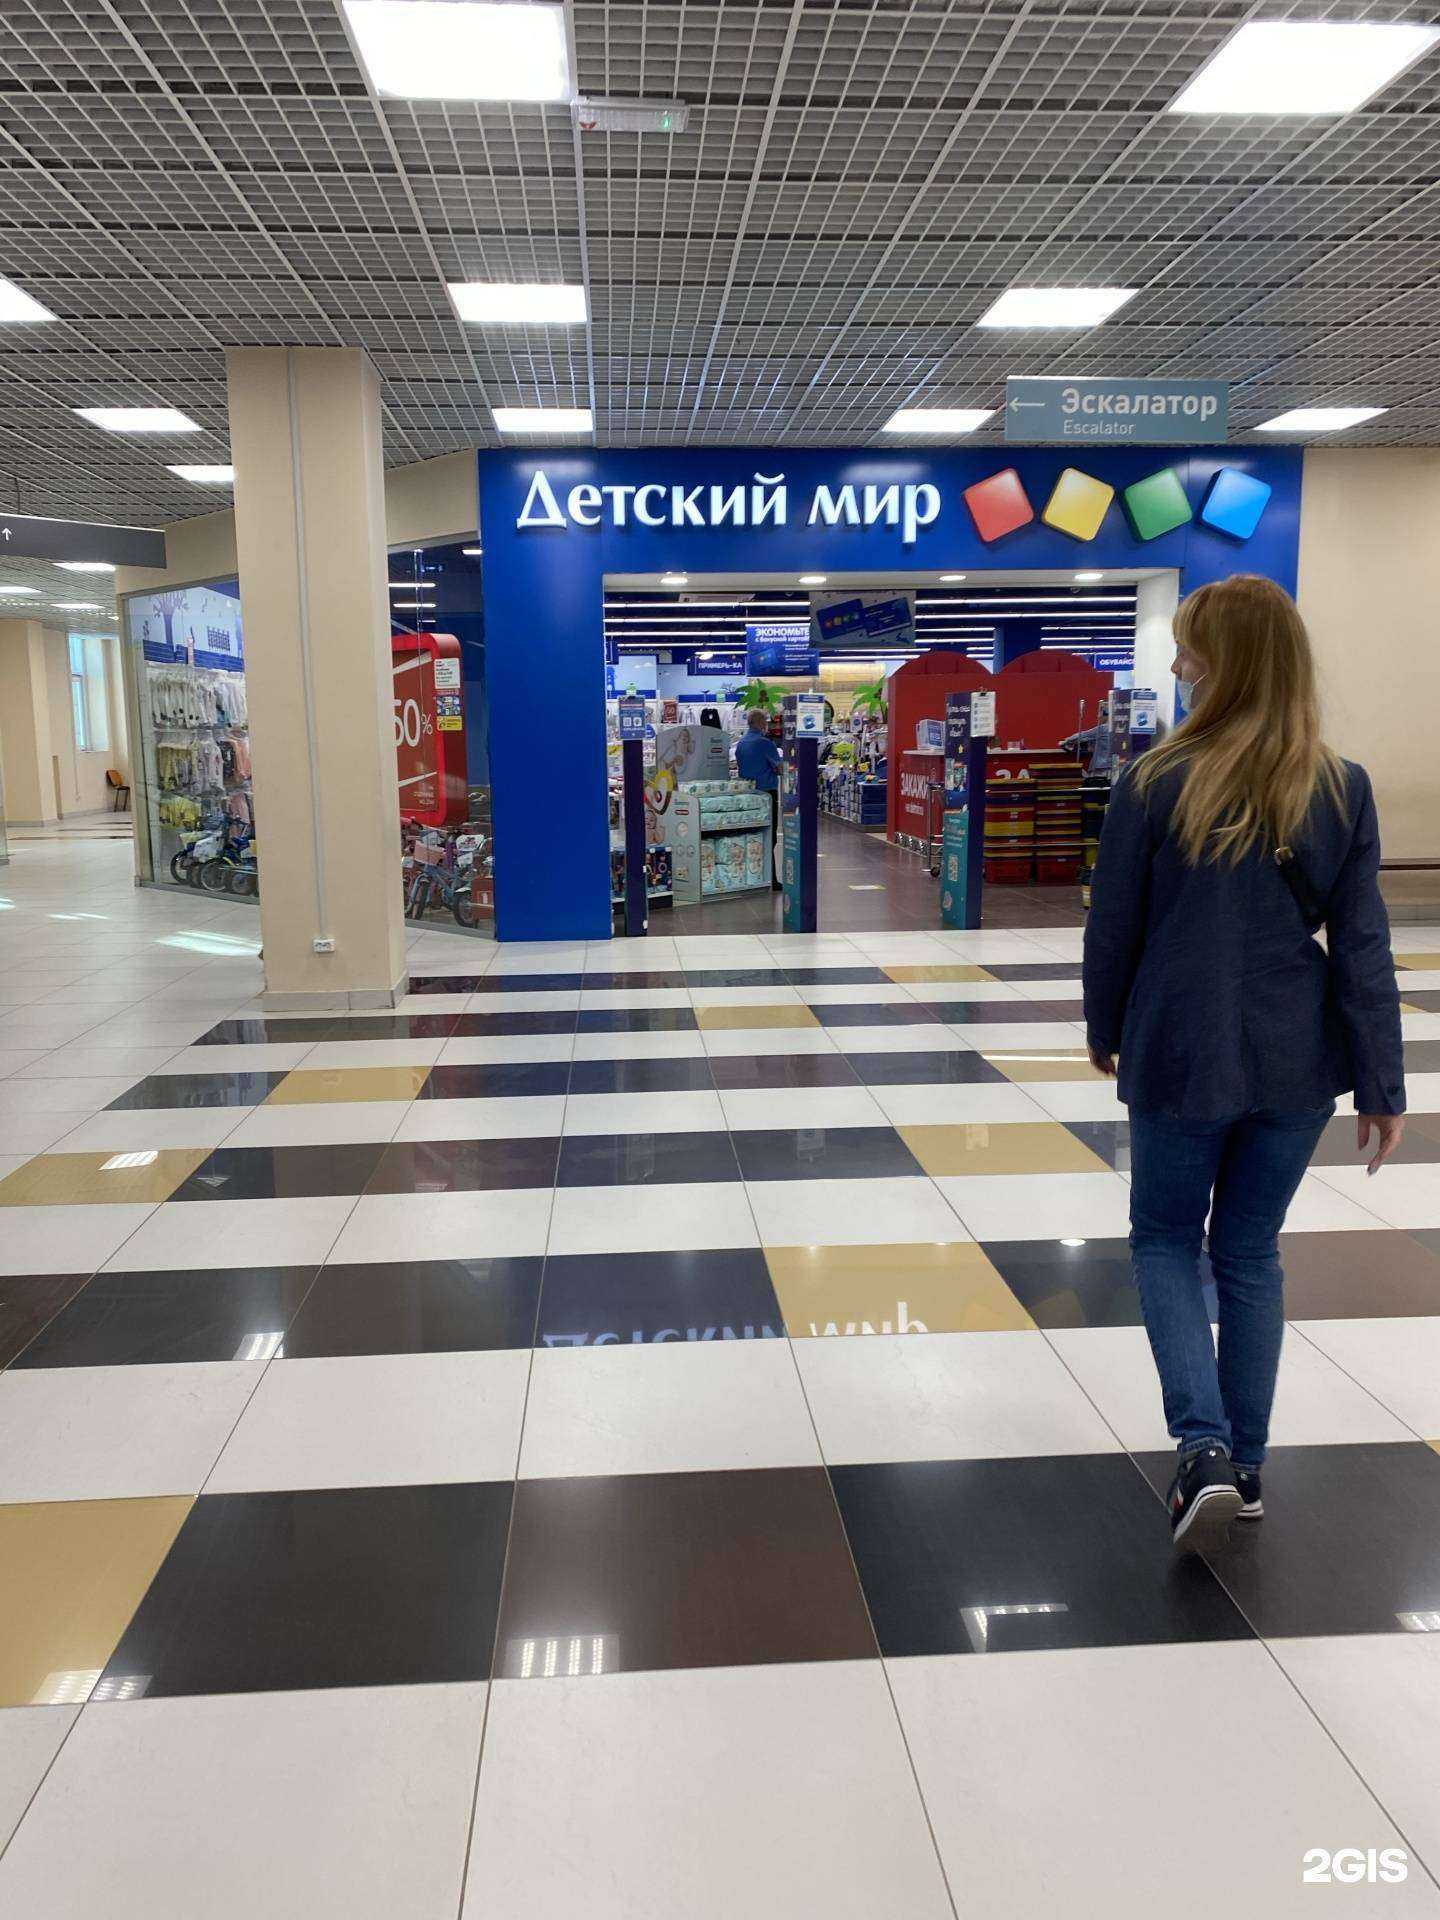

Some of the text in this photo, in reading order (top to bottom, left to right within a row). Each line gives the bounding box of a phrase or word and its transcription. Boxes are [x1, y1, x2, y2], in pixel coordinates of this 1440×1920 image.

[1061, 387, 1218, 422] Эскалатор
[1063, 420, 1136, 435] Escalator
[516, 470, 942, 544] Детский мир
[755, 627, 810, 637] ЭКОНОМЬТЕ
